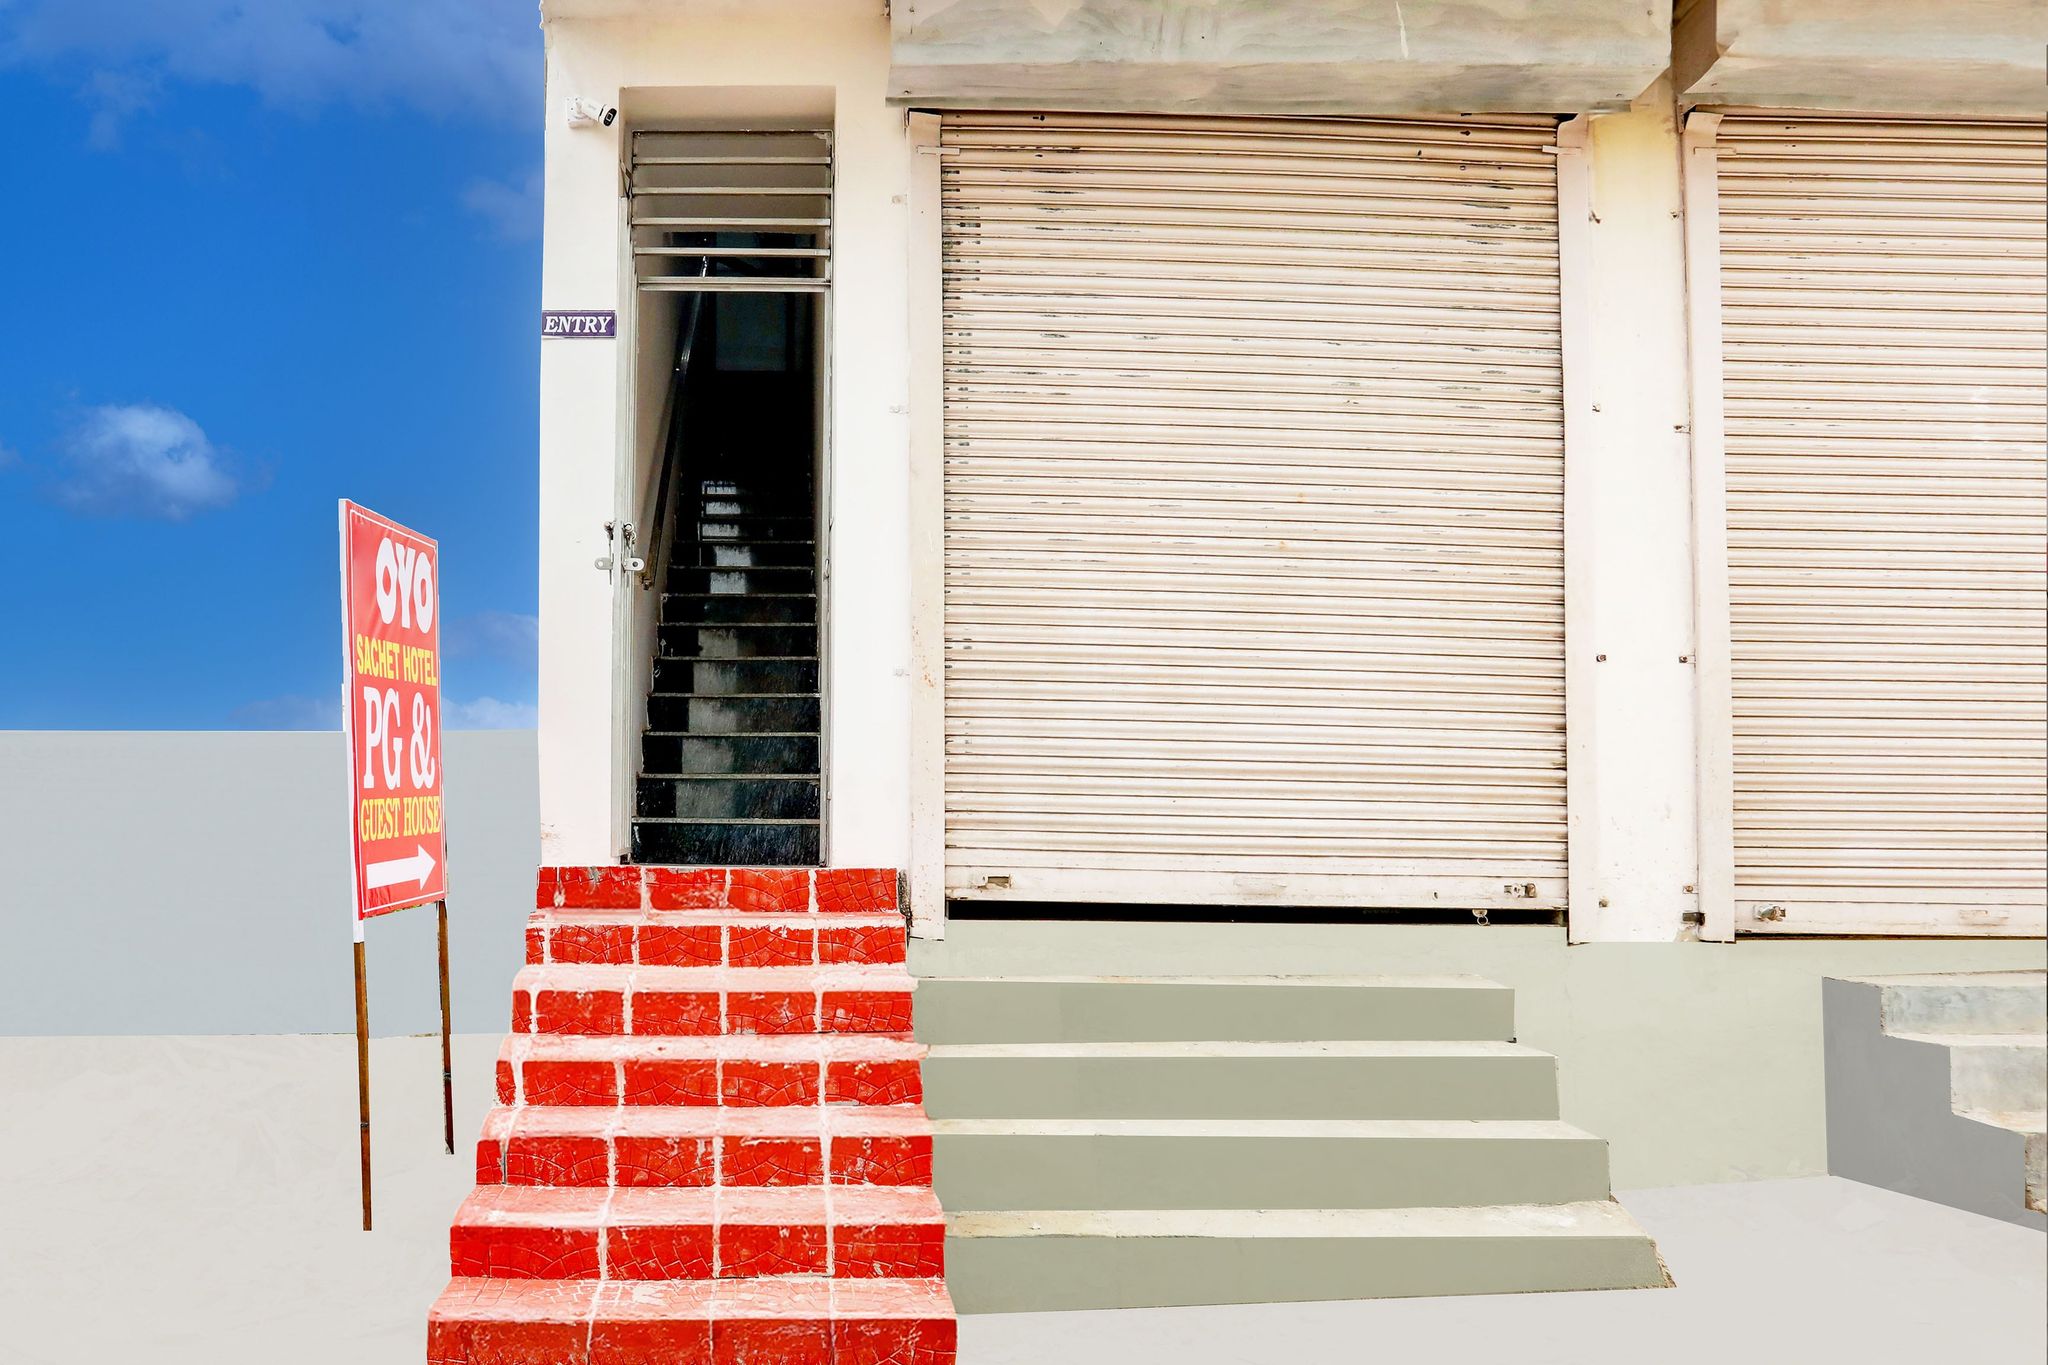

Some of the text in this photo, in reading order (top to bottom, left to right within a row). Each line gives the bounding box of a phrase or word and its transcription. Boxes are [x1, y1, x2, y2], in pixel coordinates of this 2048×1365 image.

[544, 316, 612, 333] ENTRY
[376, 537, 434, 634] OYO
[357, 633, 438, 686] SACHET HOTEL
[363, 686, 435, 790] PG &
[361, 796, 440, 842] GUEST HOUSE
